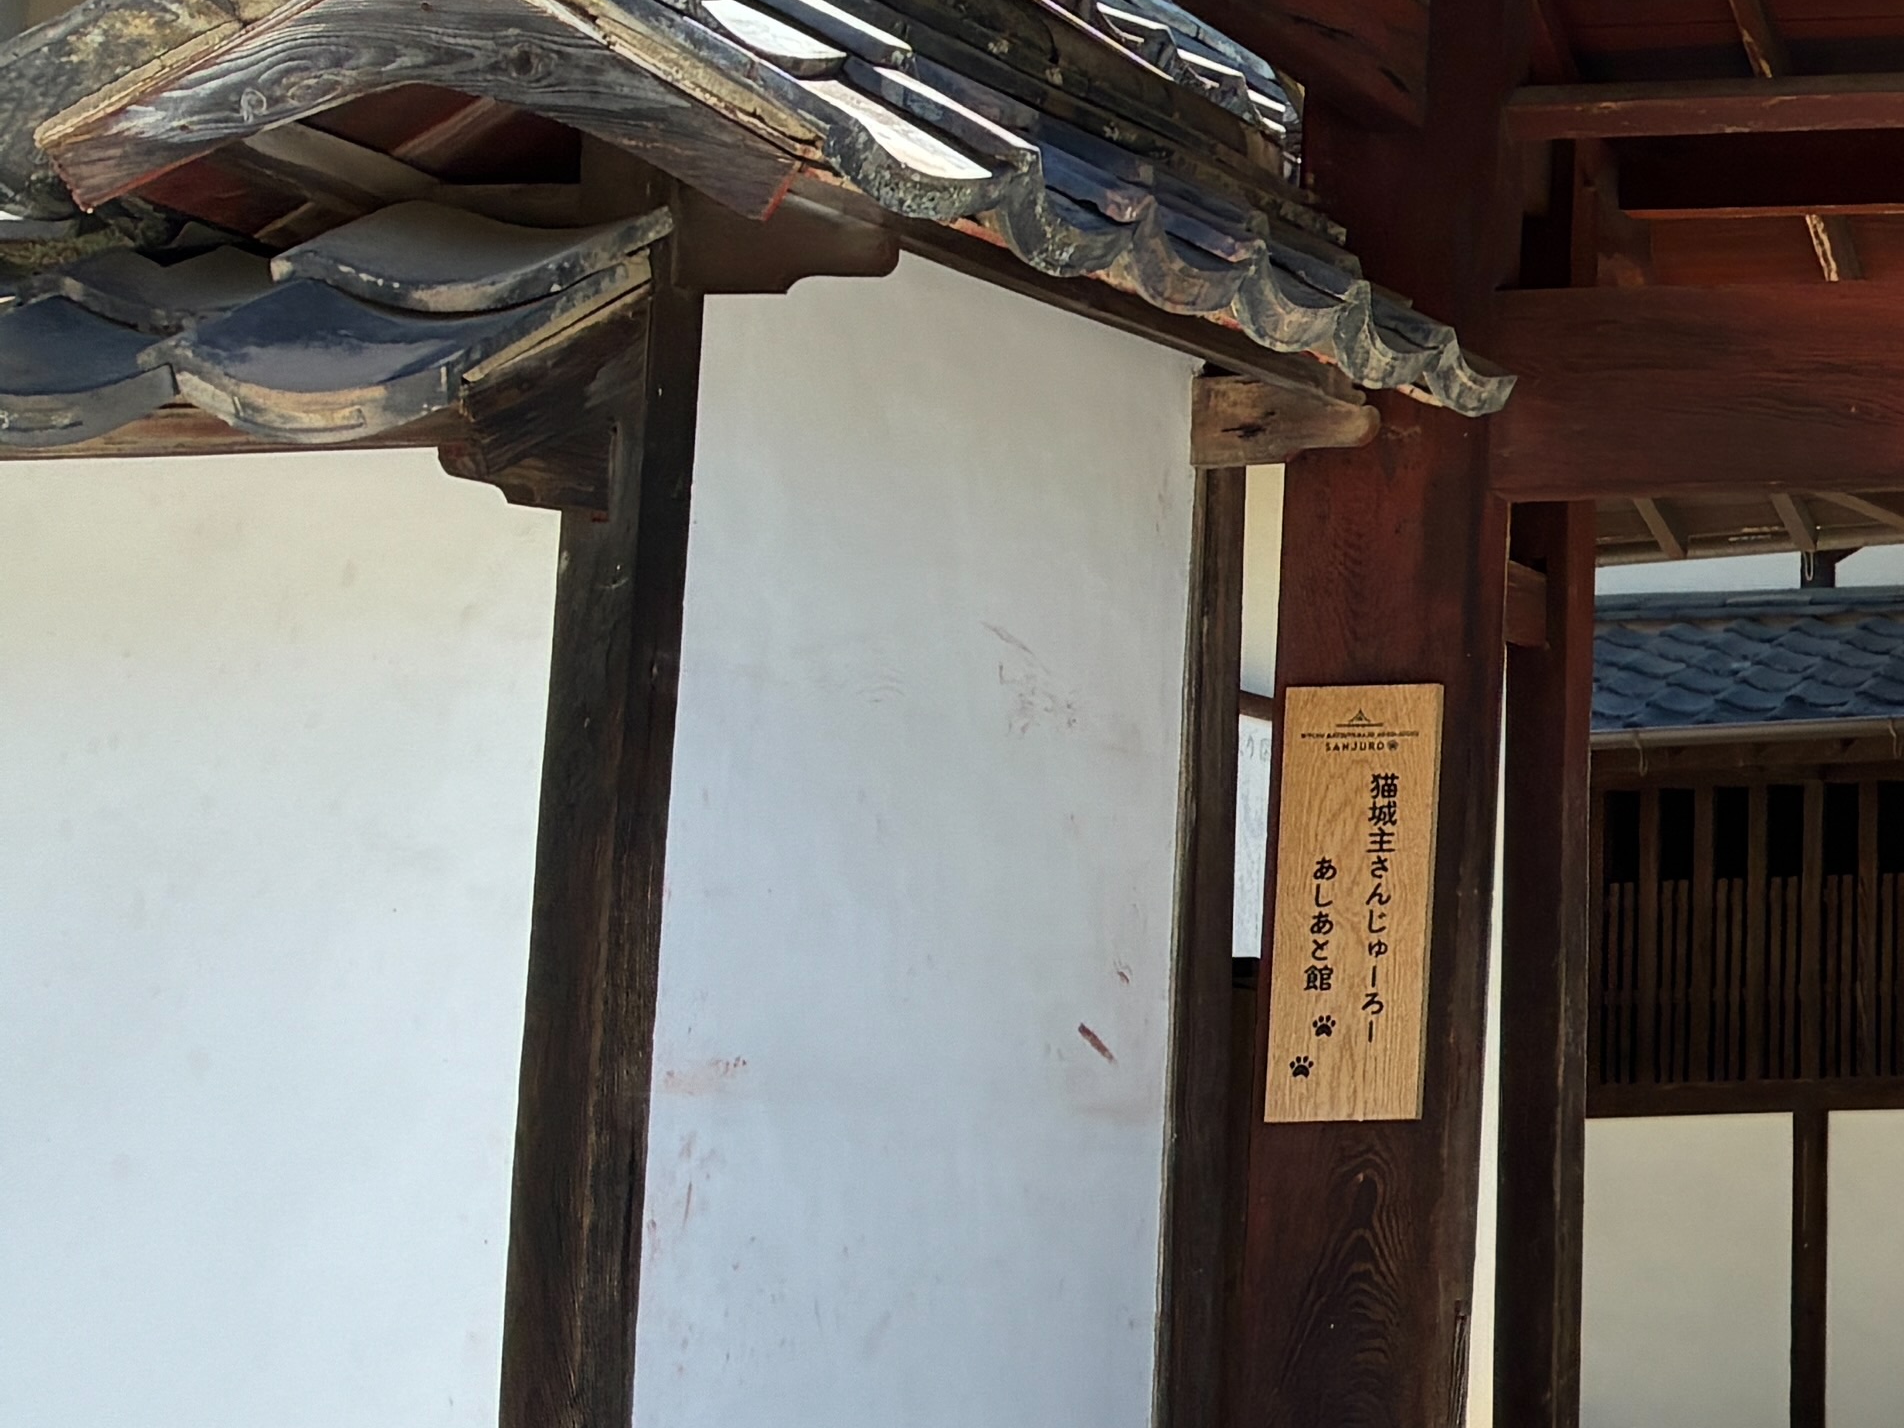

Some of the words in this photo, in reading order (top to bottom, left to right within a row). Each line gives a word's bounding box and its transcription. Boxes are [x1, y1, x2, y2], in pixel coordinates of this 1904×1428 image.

[1325, 740, 1385, 752] SANJURO
[1303, 856, 1338, 992] あしあと館
[1361, 773, 1399, 1043] 猫城主さんじゅーろー
